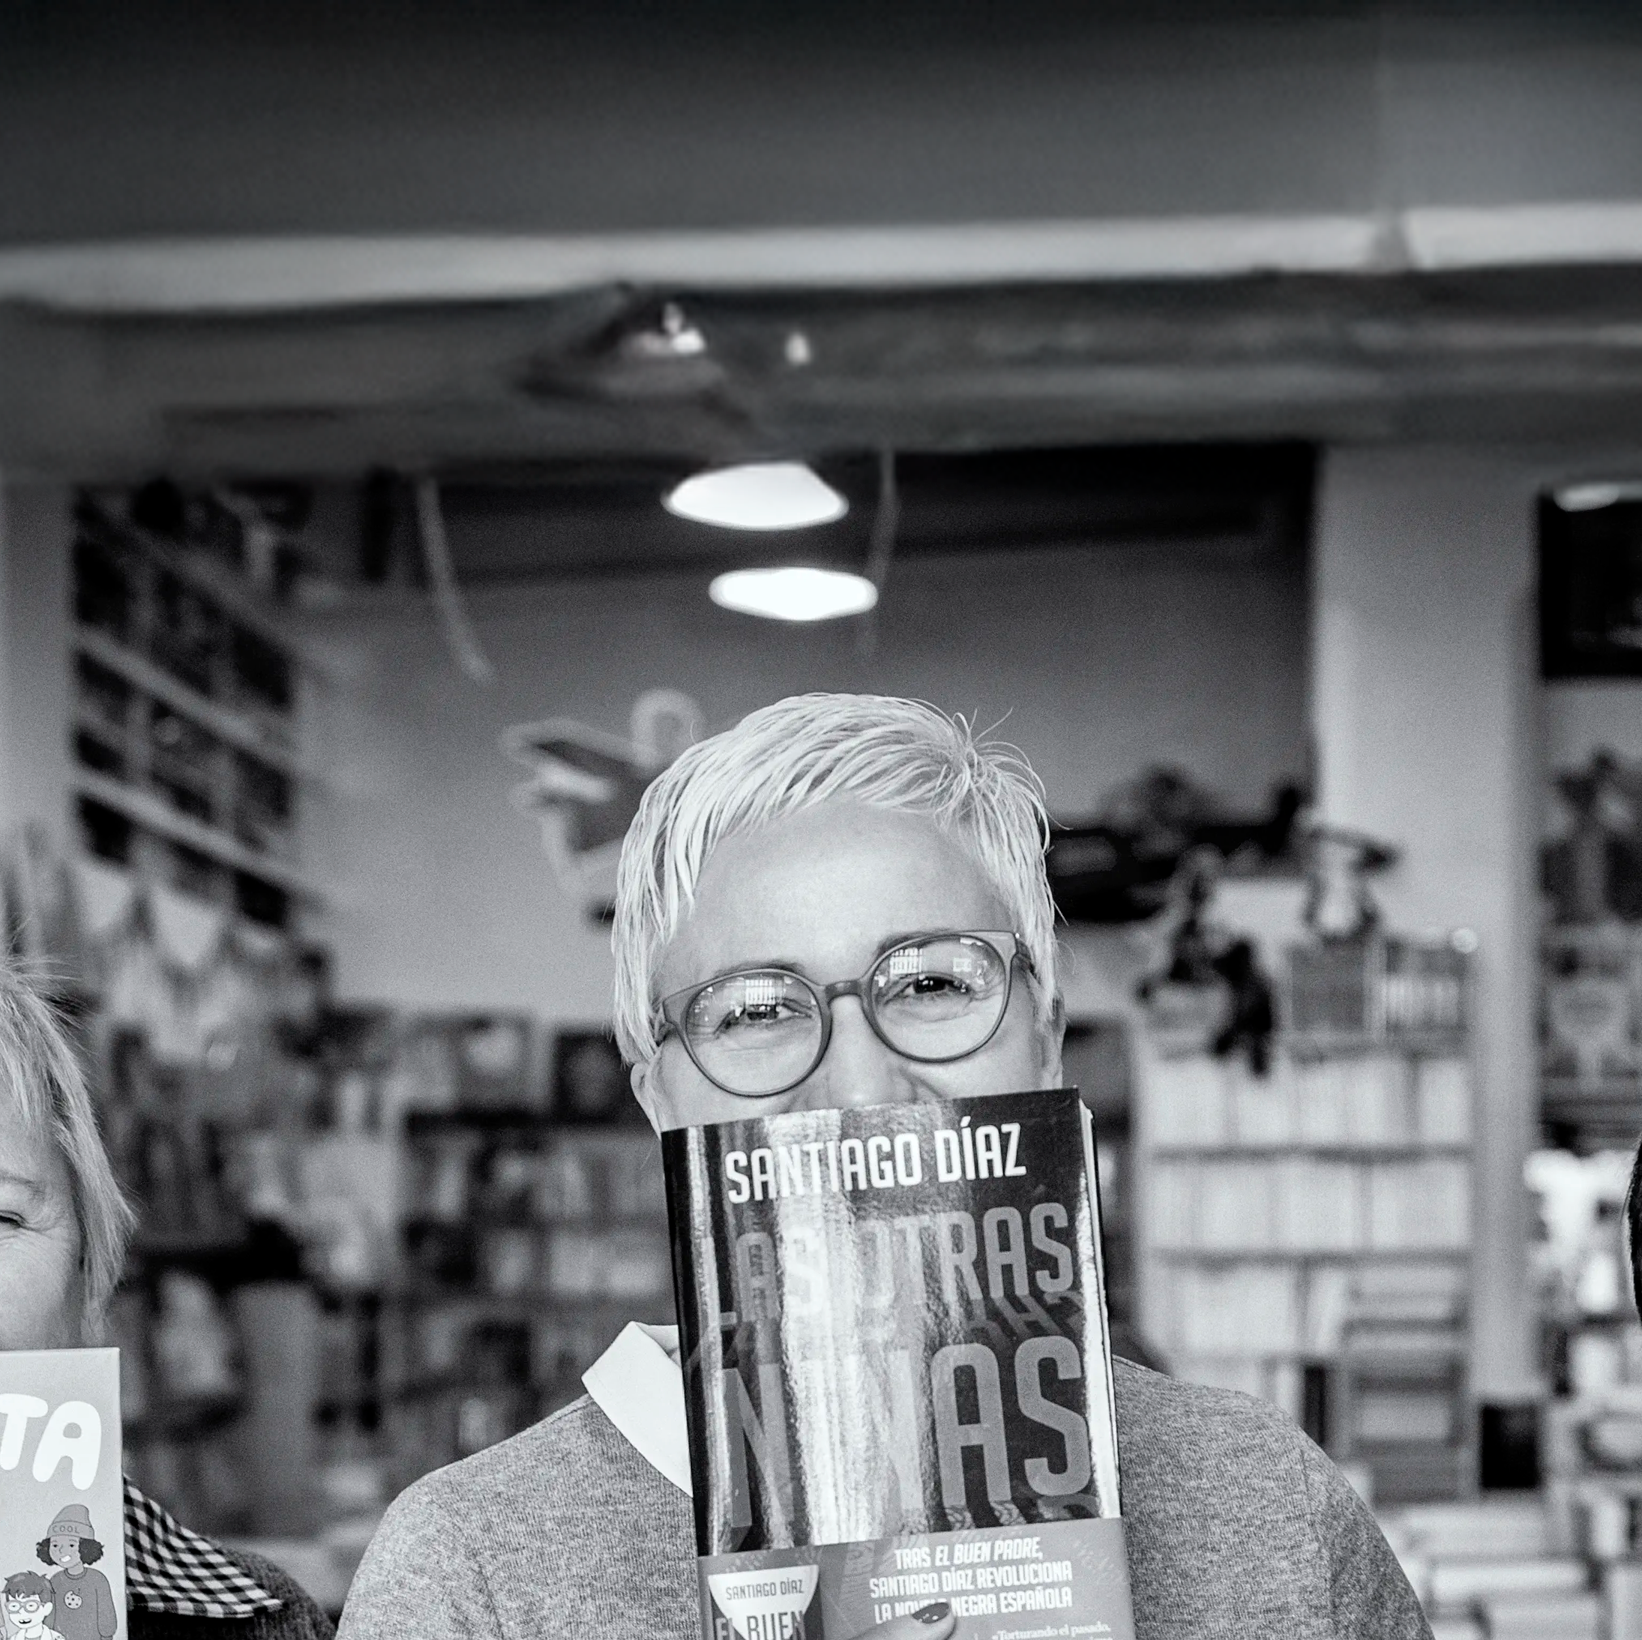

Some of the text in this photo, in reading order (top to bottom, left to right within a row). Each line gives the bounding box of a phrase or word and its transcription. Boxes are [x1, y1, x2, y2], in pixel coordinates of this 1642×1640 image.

[724, 1115, 1027, 1203] SANTIAGO DÍAZ
[52, 1525, 80, 1534] COOL
[895, 1537, 1044, 1570] TRAS EL BUEN PADRE,
[725, 1577, 804, 1600] SANTIAGO DÍAZ
[869, 1560, 1073, 1598] SANTIAGO DÍAZ REVOLUCIONA
[874, 1603, 893, 1625] LA
[951, 1593, 998, 1617] NEGRA
[1000, 1586, 1073, 1613] ESPAÑOLA
[1059, 1624, 1070, 1636] el
